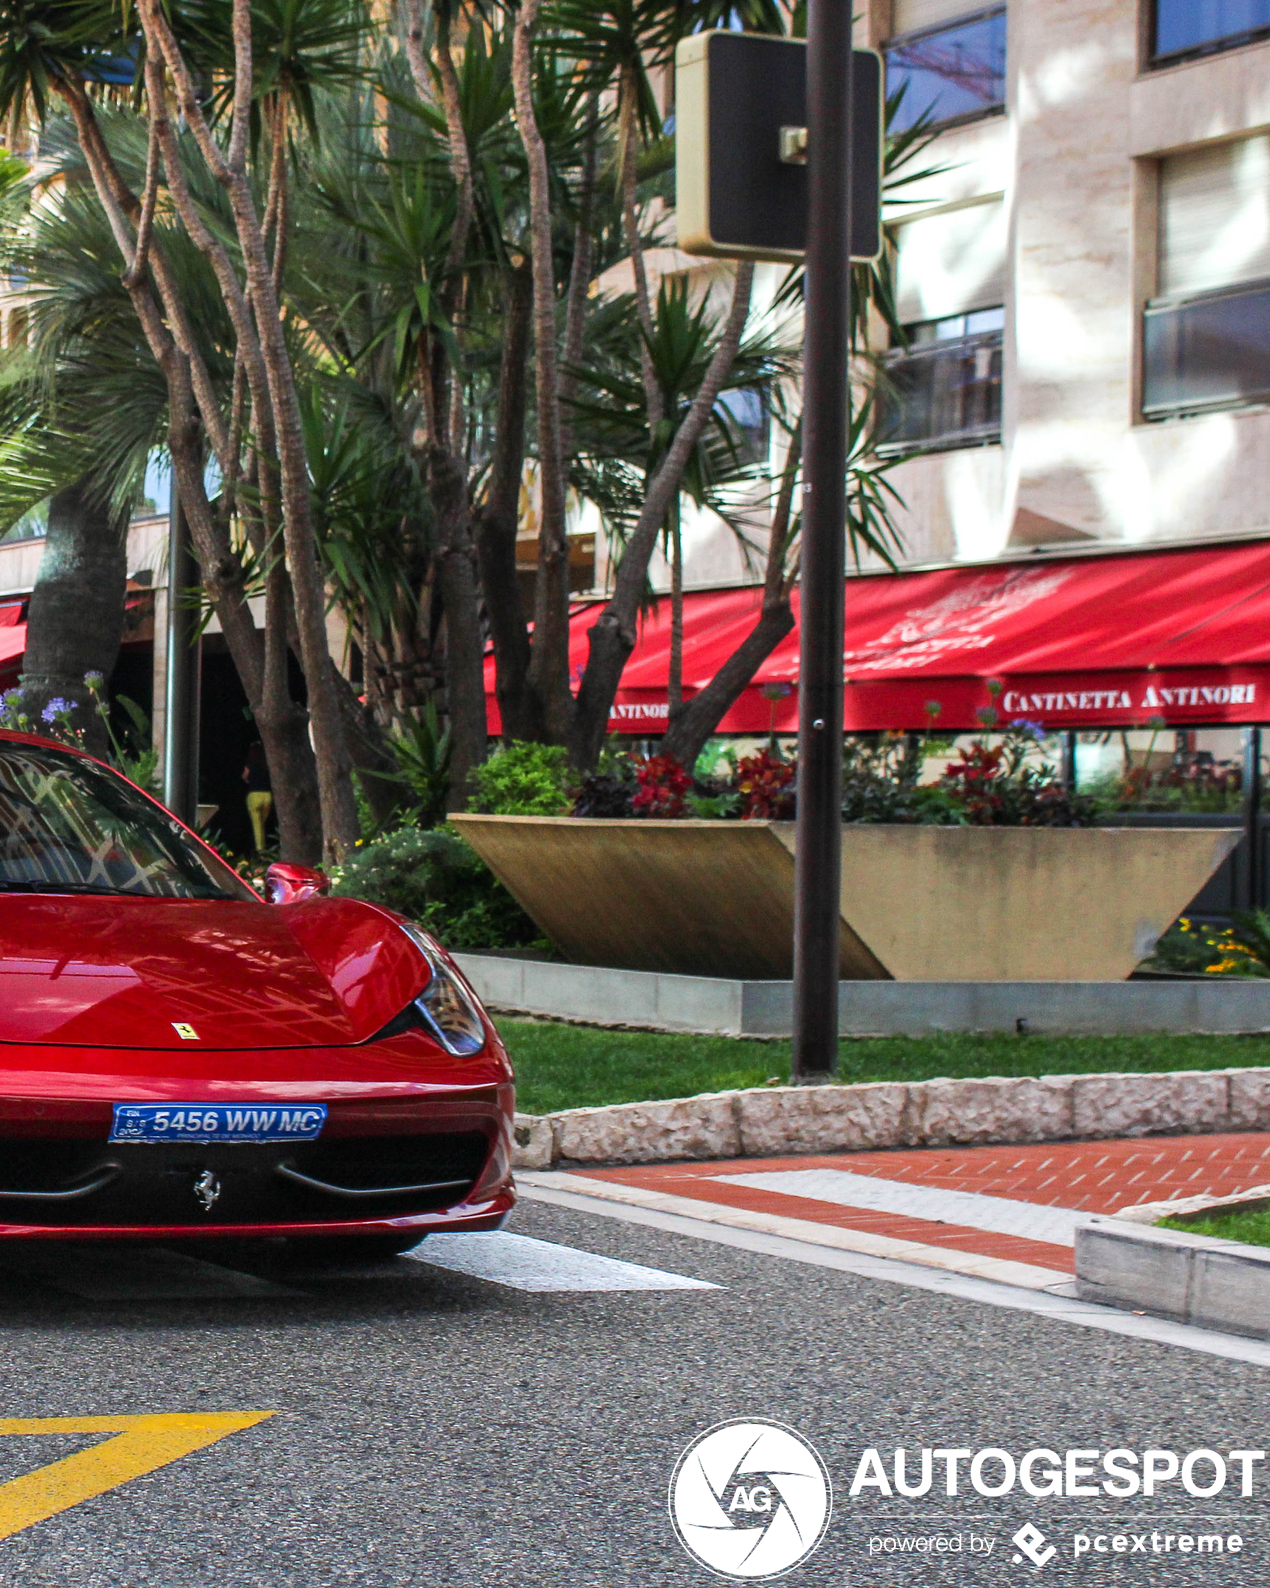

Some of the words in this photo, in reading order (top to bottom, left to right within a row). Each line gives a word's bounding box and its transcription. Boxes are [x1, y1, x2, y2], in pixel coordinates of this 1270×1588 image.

[1003, 690, 1131, 713] CANTINETTA
[1141, 684, 1256, 708] ANTINORI
[610, 704, 669, 719] ANTINOR
[153, 1111, 218, 1131] 5456
[226, 1111, 277, 1131] WW
[278, 1111, 320, 1131] MC
